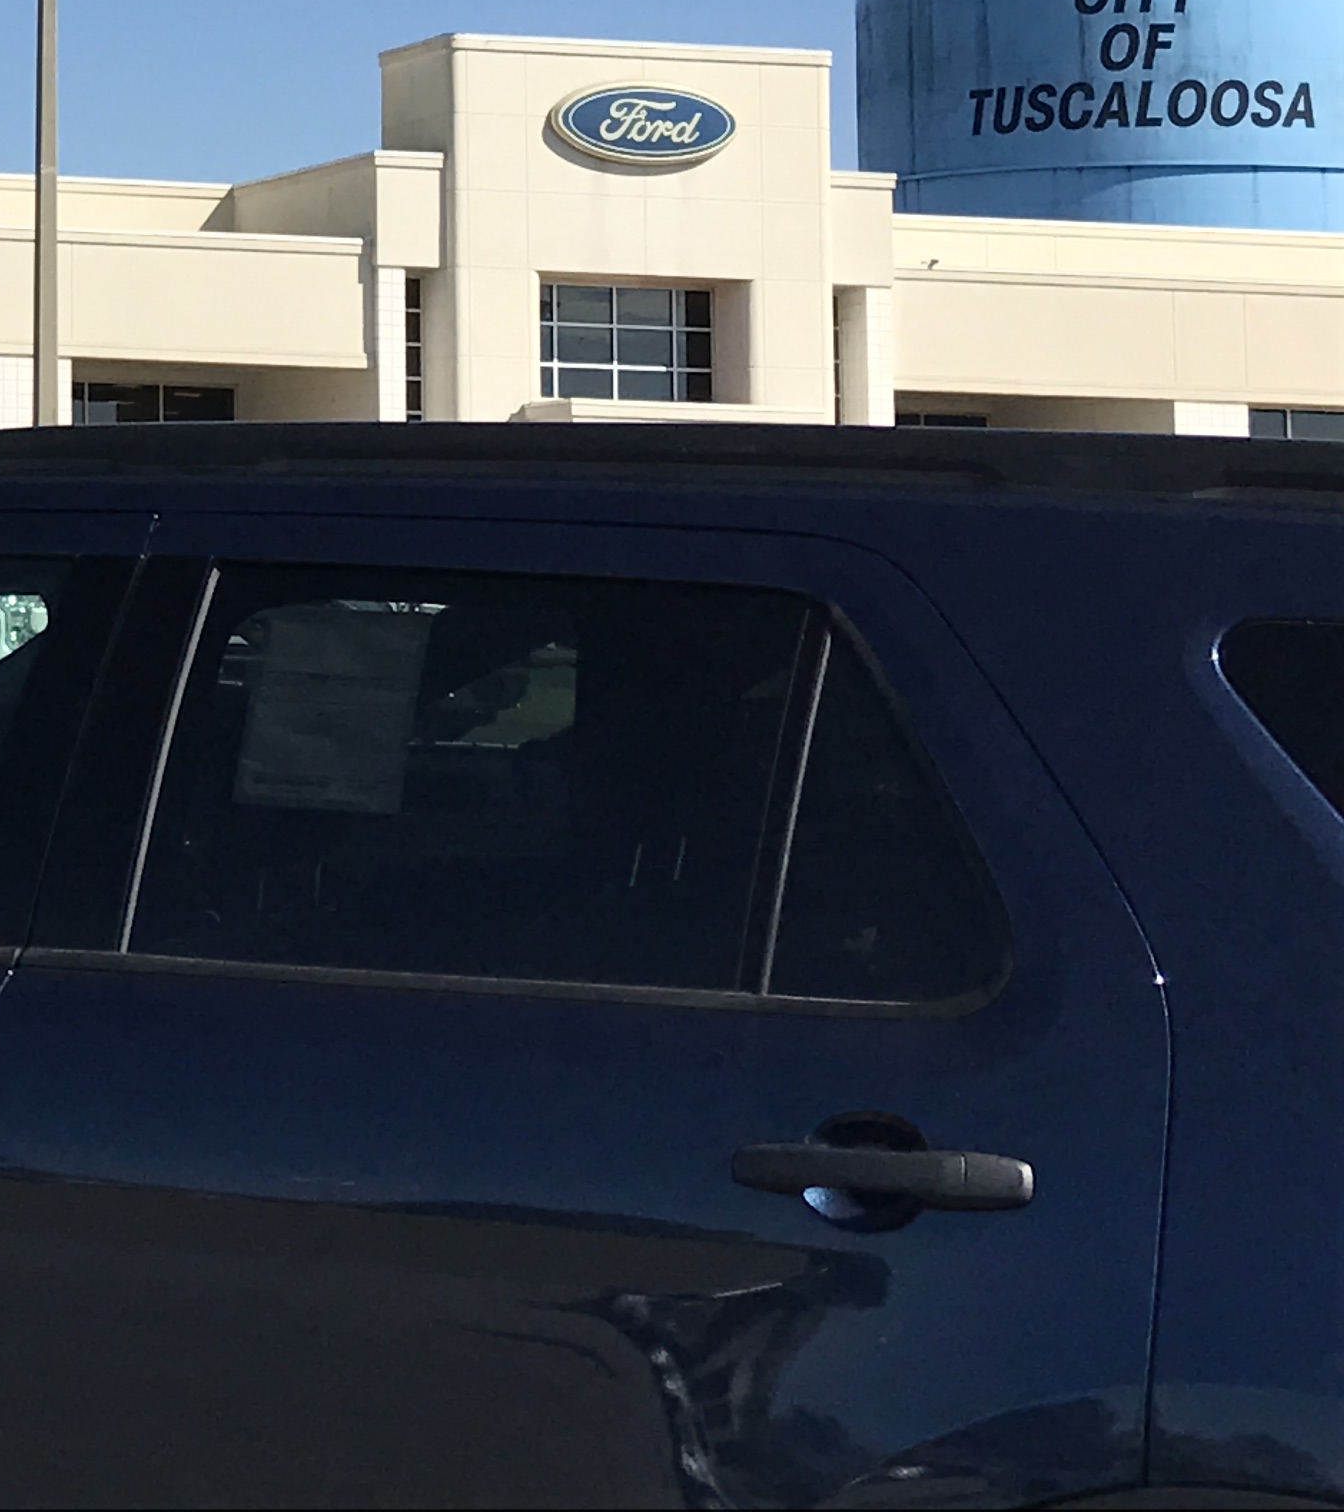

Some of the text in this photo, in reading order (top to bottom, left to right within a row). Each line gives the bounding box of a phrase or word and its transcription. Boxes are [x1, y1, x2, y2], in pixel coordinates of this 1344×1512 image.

[1099, 22, 1175, 72] OF
[599, 98, 703, 144] Ford
[969, 79, 1316, 136] TUSCALOOSA
